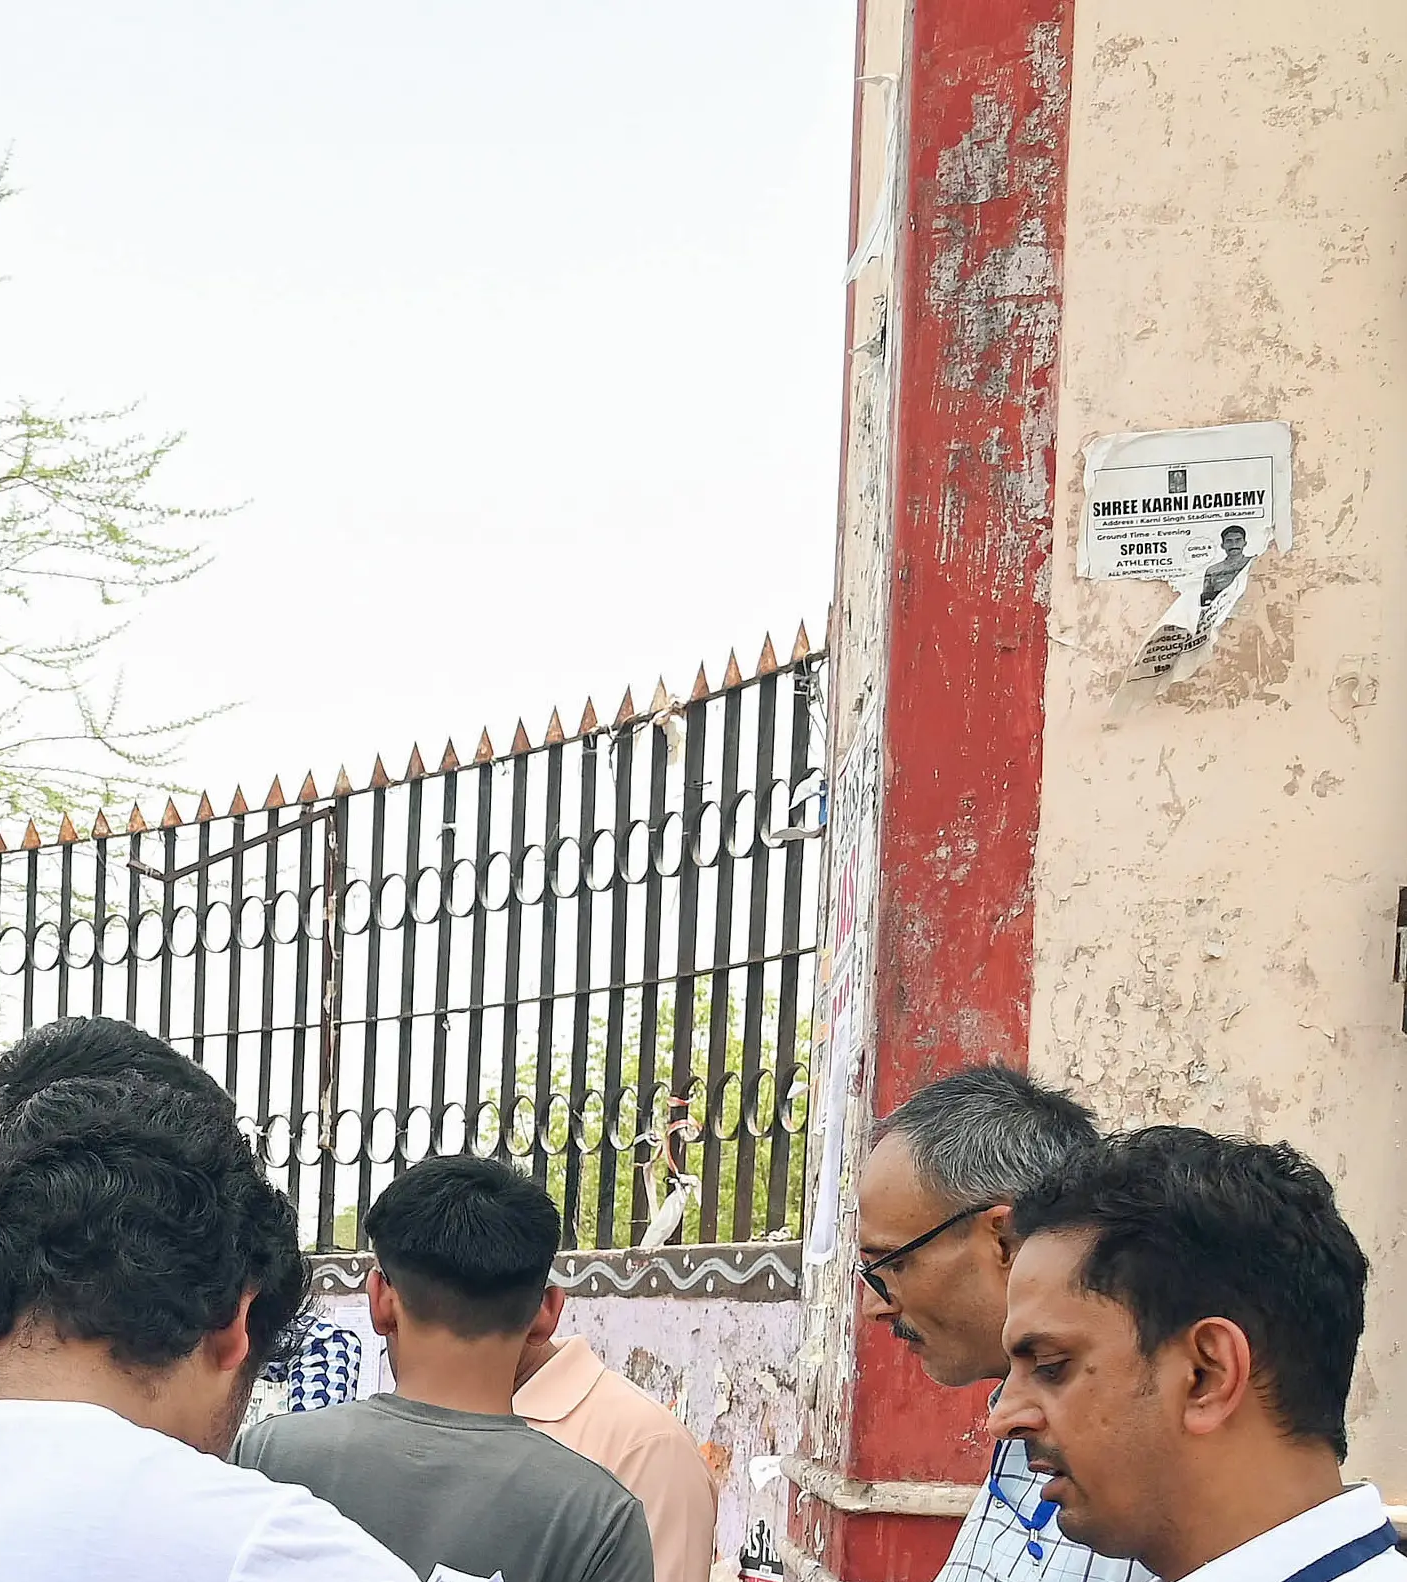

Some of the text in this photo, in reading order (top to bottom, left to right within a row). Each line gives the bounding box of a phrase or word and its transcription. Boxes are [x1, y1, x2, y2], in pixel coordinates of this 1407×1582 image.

[1093, 490, 1265, 517] SHREE KARNI ACADEMY
[1140, 516, 1161, 524] Karni
[1163, 515, 1185, 523] Singh
[1097, 532, 1128, 540] Ground
[1157, 528, 1191, 537] Evening
[1120, 541, 1167, 556] SPORTS
[1116, 557, 1173, 567] ATHLETICS
